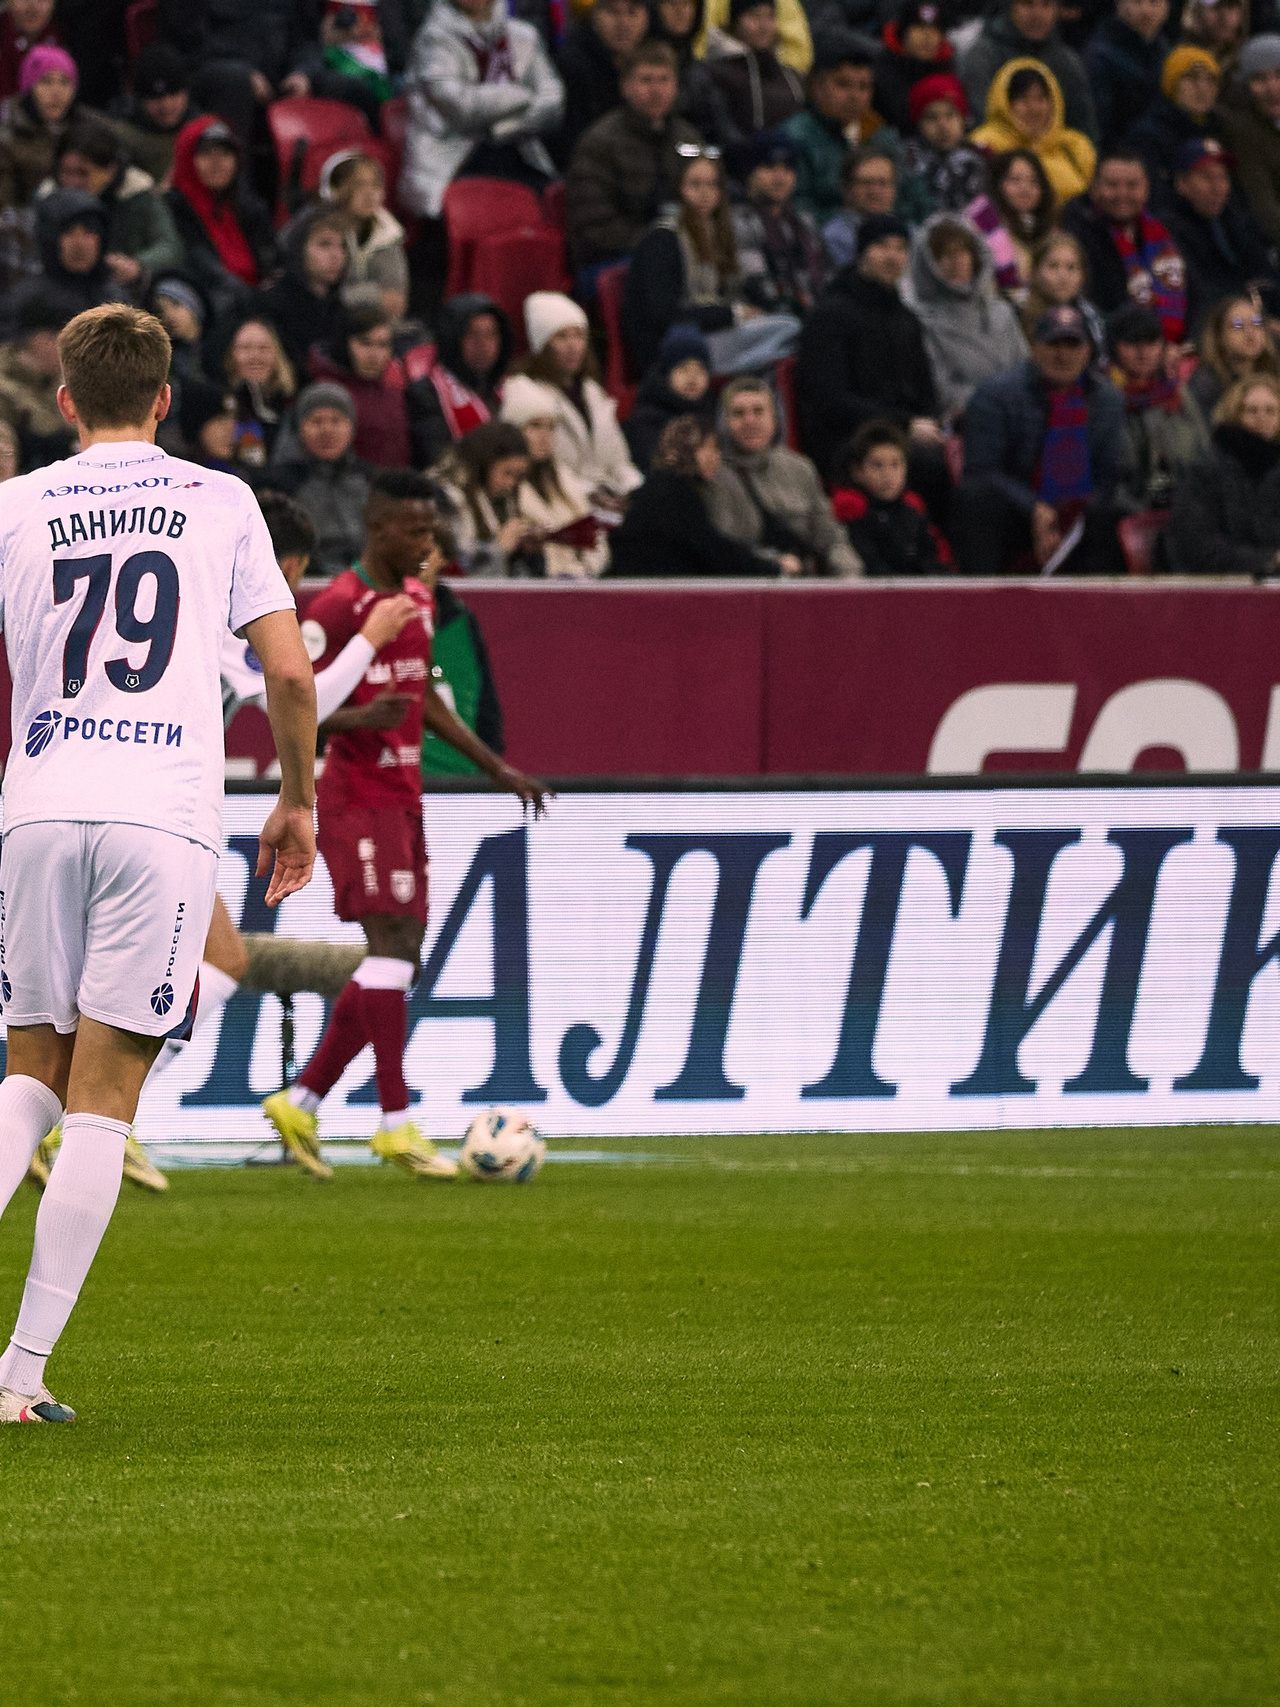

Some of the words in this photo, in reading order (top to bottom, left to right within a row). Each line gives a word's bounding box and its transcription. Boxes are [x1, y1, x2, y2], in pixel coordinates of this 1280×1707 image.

[41, 476, 174, 500] АЭРОФЛОТ
[47, 506, 187, 551] ДАНИЛОВ
[52, 550, 181, 699] 79
[63, 716, 183, 748] РОССЕТИ
[166, 902, 185, 977] РОССЕТИ
